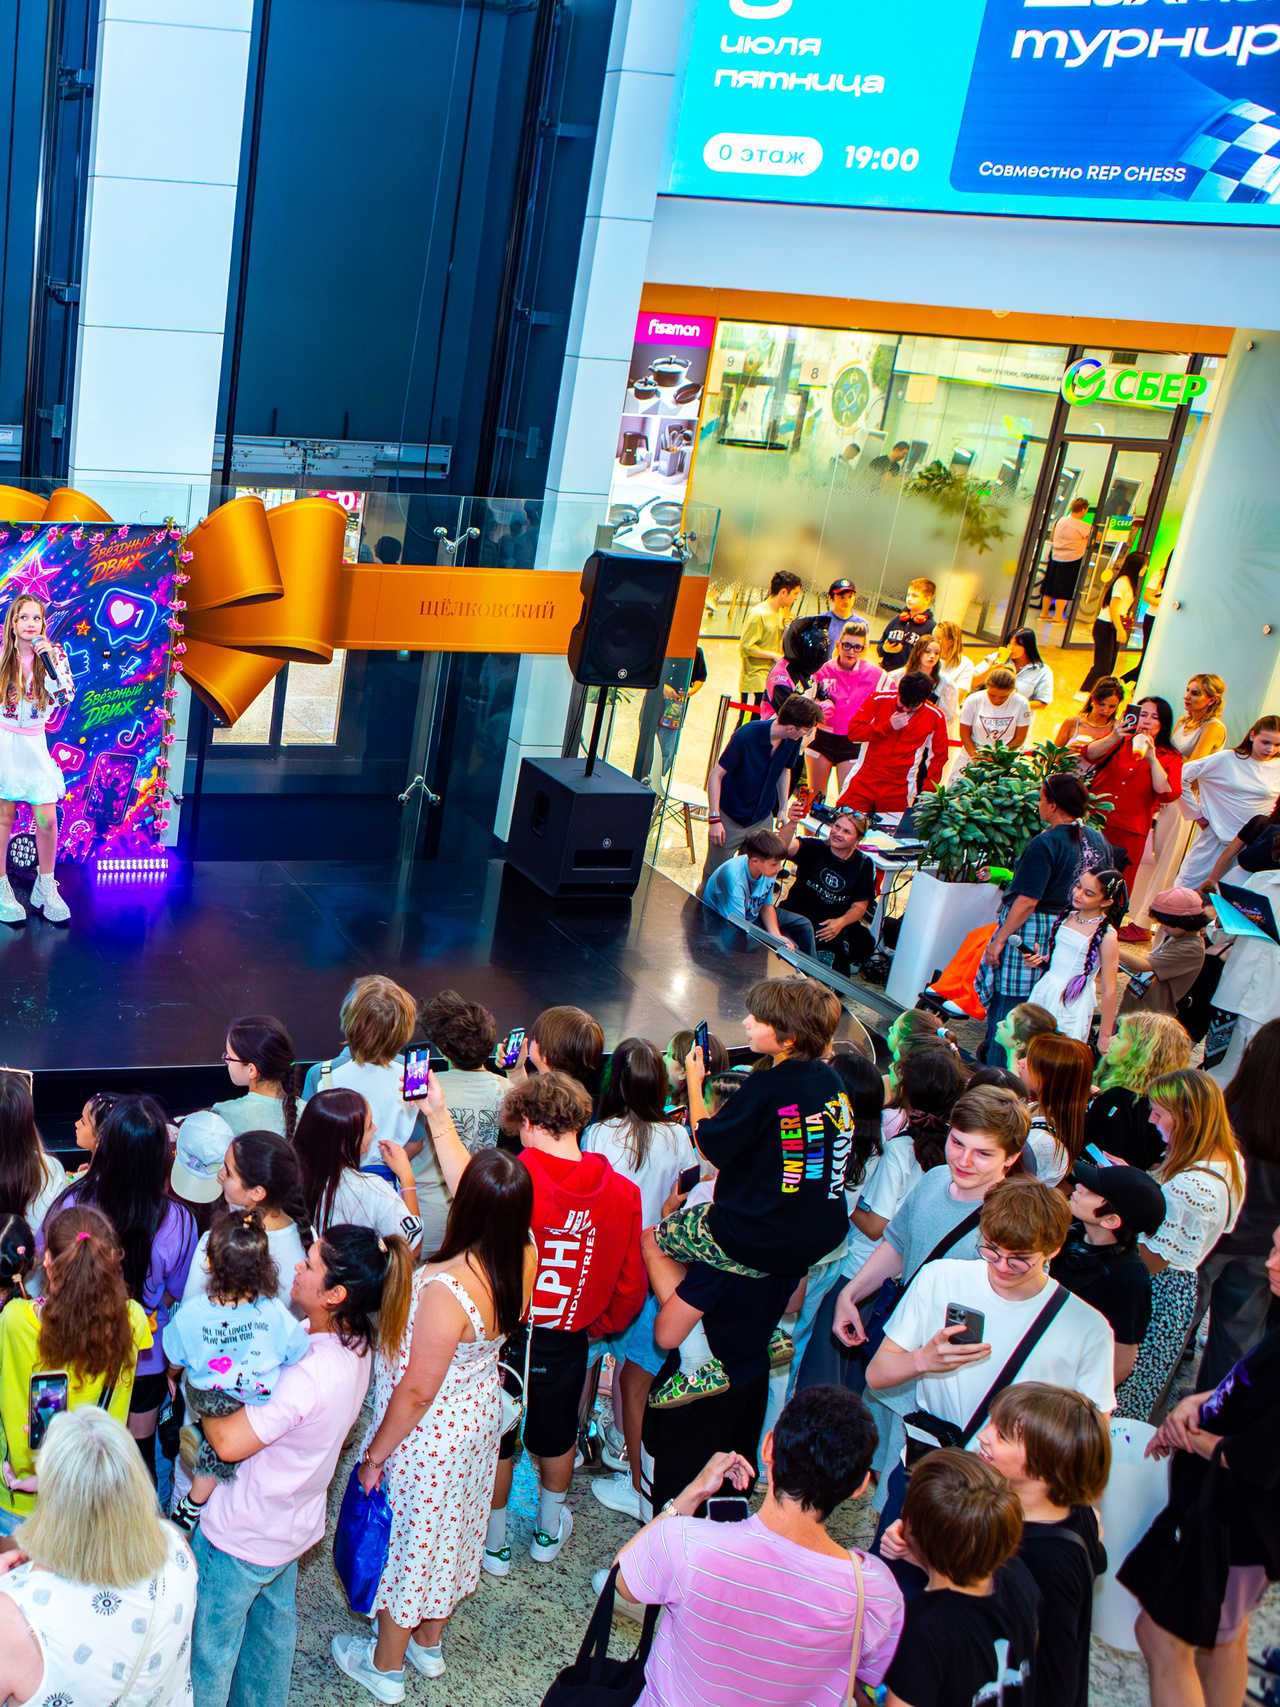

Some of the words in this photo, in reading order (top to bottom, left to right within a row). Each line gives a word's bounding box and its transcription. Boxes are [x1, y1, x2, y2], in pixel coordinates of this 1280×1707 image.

[720, 34, 822, 57] июля
[713, 68, 886, 97] пятница
[718, 144, 733, 161] 0
[740, 148, 805, 165] этаж
[844, 145, 920, 172] 19:00
[978, 161, 1083, 180] Совместно
[1086, 164, 1122, 182] REP
[1123, 166, 1187, 183] CHESS
[726, 356, 735, 368] 9
[810, 367, 820, 379] 8
[1113, 369, 1208, 405] СБЕР
[419, 597, 556, 621] ЩЁЛКОВСКИЙ
[984, 718, 1009, 727] GUESS
[777, 1103, 804, 1194] FUNTHERA
[805, 1112, 825, 1180] MILITIA
[564, 1226, 596, 1331] INDUSTRIES
